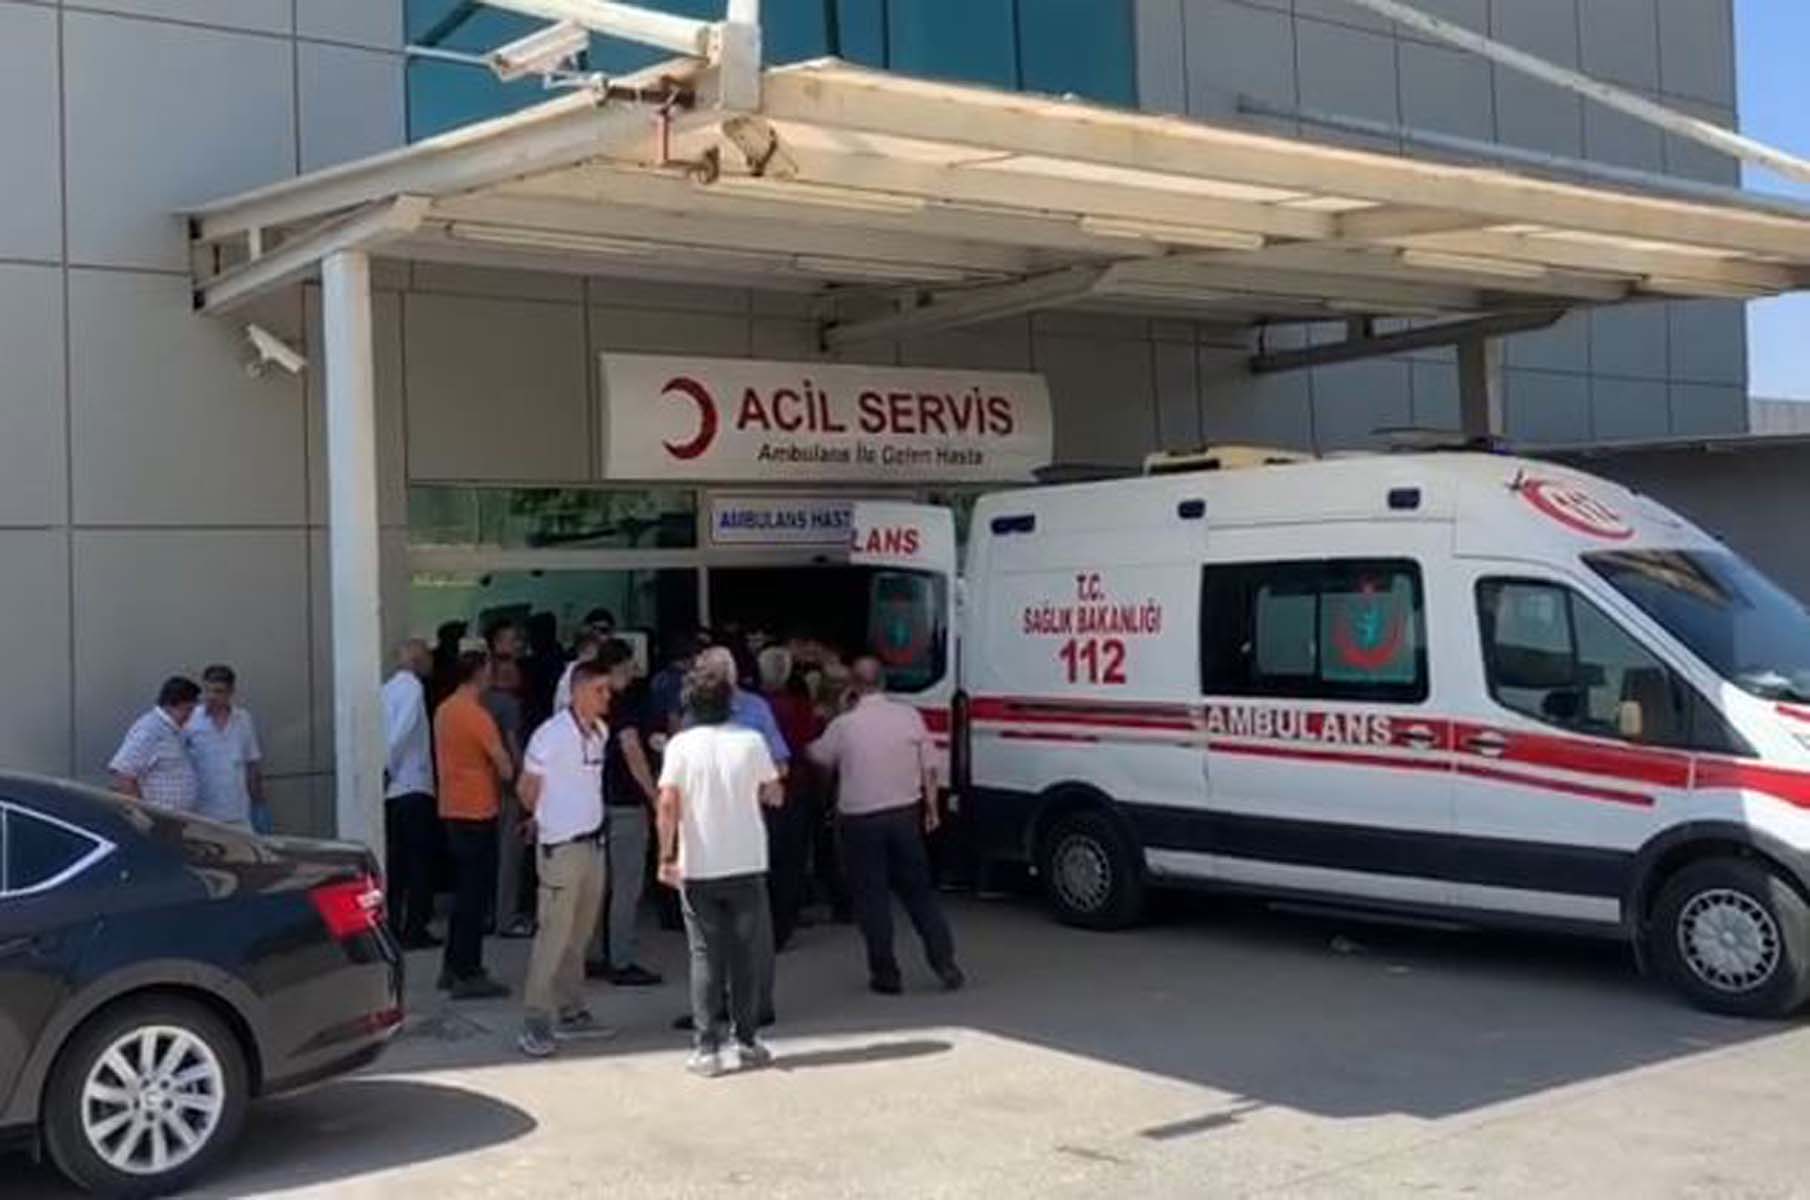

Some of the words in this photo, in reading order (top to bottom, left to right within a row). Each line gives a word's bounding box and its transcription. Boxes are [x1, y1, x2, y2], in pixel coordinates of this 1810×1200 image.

[737, 379, 846, 432] ACİL
[858, 387, 1014, 435] SERVİS
[757, 442, 850, 463] Ambulans
[936, 448, 983, 466] Hasta
[719, 510, 808, 530] AMBULANS
[1023, 601, 1073, 635] SAĞLIK
[1076, 599, 1162, 634] BAKANLIĞI
[1060, 638, 1127, 684] 112
[1207, 704, 1394, 745] AMBULANS
